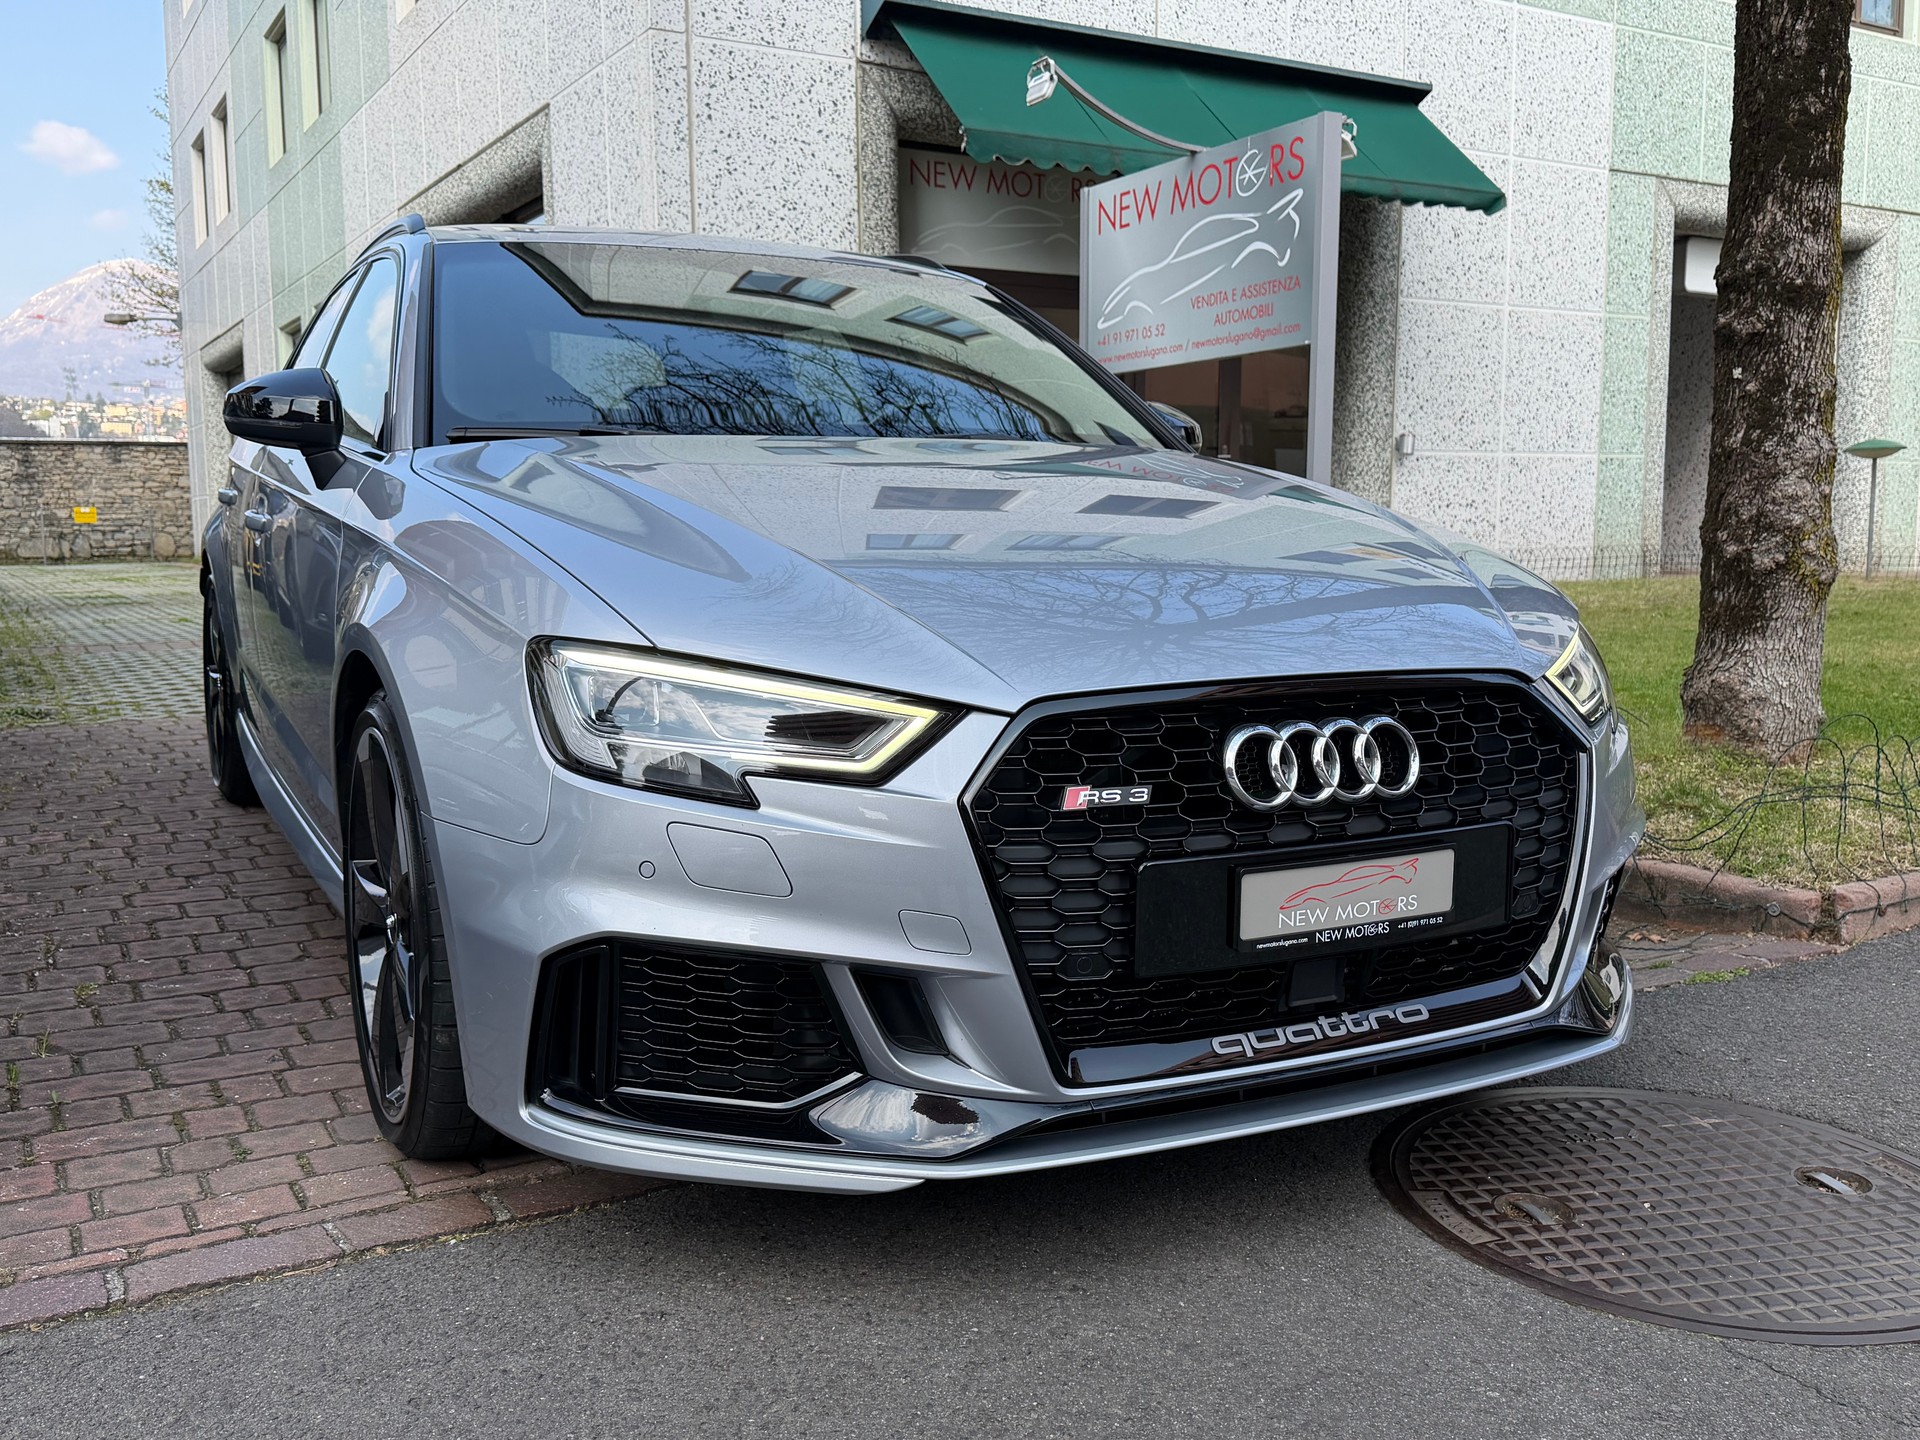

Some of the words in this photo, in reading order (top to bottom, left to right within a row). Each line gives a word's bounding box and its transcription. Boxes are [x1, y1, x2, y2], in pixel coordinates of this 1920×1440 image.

[909, 158, 978, 192] NEW
[1098, 180, 1162, 235] NEW
[1170, 136, 1305, 215] MOTORS
[1190, 290, 1229, 310] VENDITA
[1231, 288, 1237, 303] E
[1240, 275, 1301, 301] ASSISTENZA
[1213, 302, 1274, 327] AUTOMOBILI
[1097, 333, 1110, 346] +41
[1113, 331, 1122, 344] 91
[1124, 327, 1139, 342] 971
[1142, 325, 1152, 340] 05
[1155, 322, 1166, 337] 52
[1191, 323, 1302, 349] newmotorslugano@gmail.com
[1076, 789, 1123, 807] RS
[1128, 787, 1149, 802] 3
[1277, 906, 1330, 929] NEW
[1335, 894, 1418, 921] MOTORS
[1315, 928, 1345, 944] NEW
[1344, 921, 1390, 940] MOTORS
[1211, 1003, 1430, 1058] quattro
